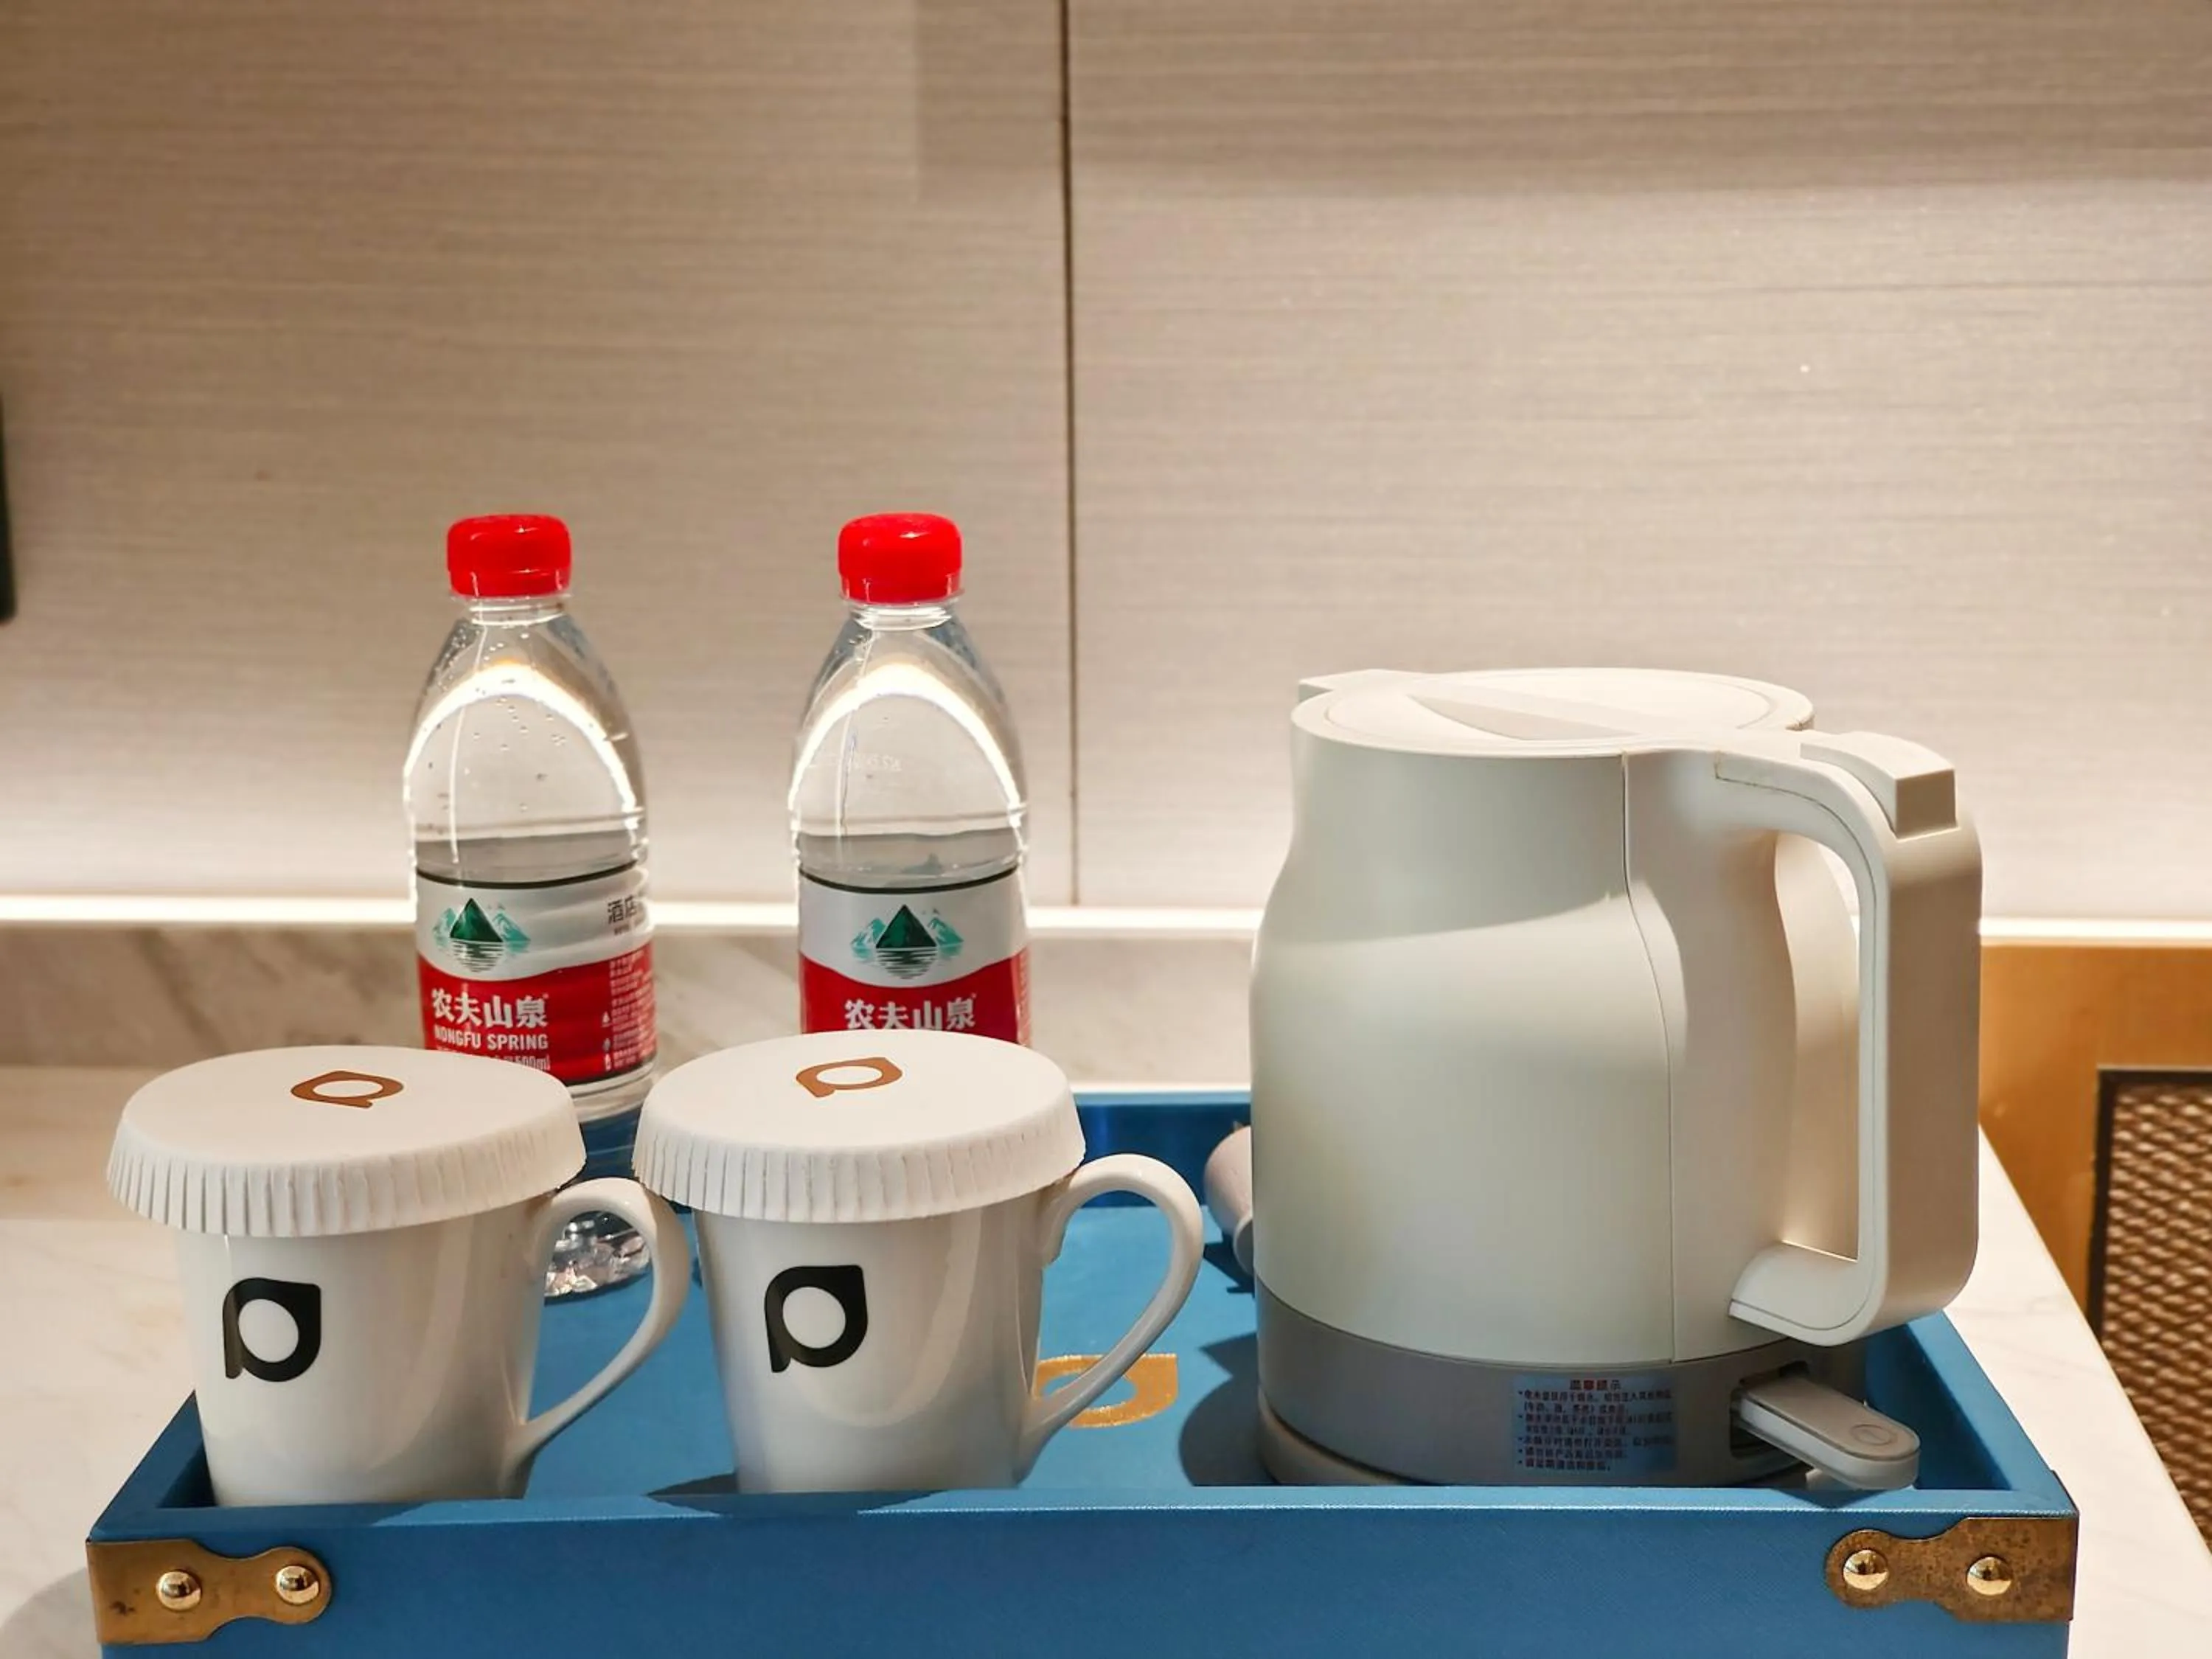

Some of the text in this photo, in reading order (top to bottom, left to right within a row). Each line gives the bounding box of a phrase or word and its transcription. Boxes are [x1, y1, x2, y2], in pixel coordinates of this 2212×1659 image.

[431, 988, 549, 1029] 农夫山泉
[844, 997, 975, 1030] 农夫山泉
[434, 1023, 481, 1049] NONGFU
[487, 1033, 549, 1051] SPRING
